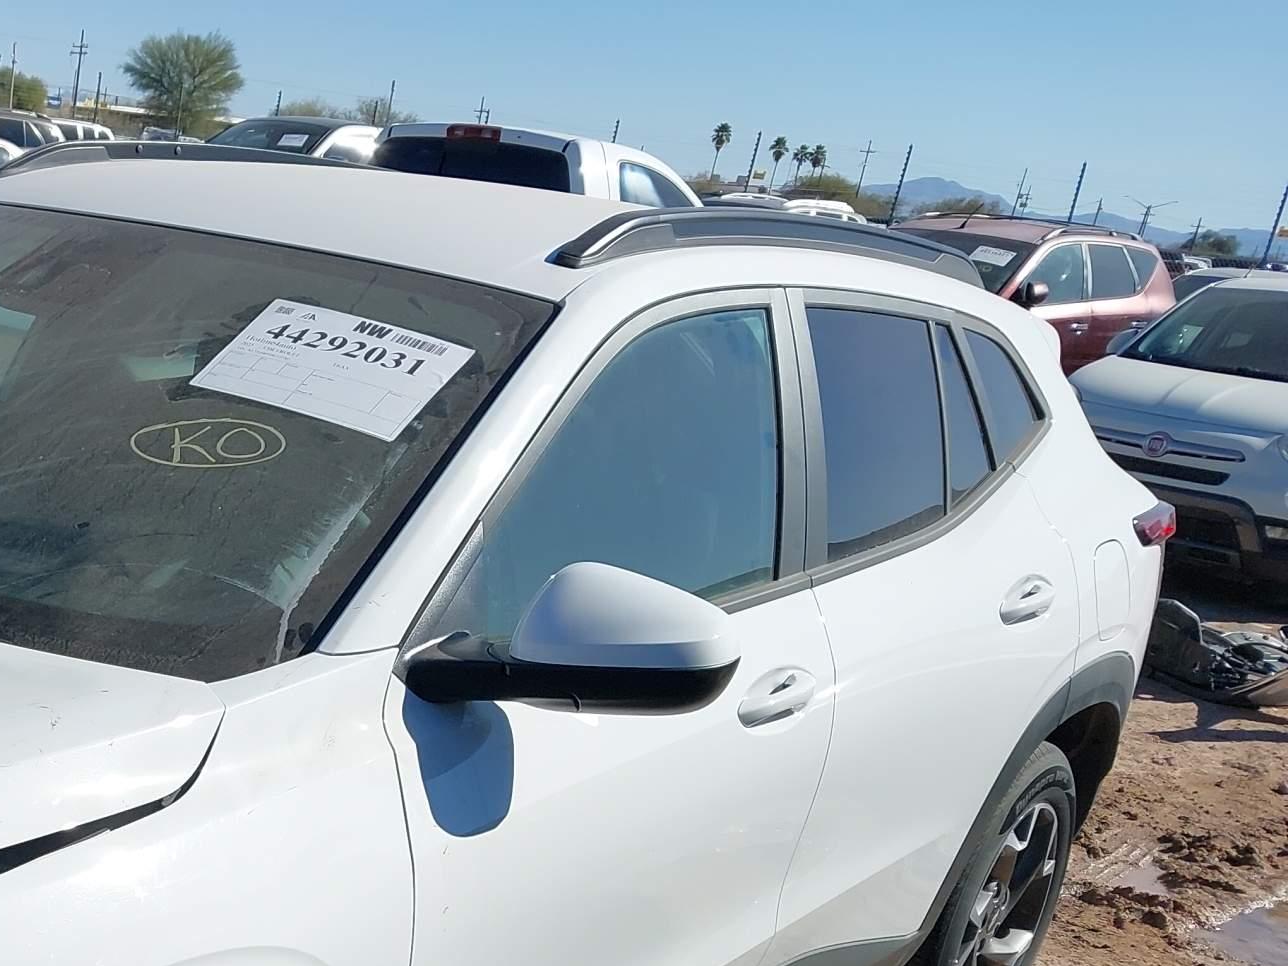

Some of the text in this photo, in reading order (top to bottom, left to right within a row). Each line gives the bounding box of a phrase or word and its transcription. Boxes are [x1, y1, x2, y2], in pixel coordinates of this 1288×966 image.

[352, 320, 393, 339] NW
[266, 323, 427, 377] 44292031
[170, 425, 266, 465] KO
